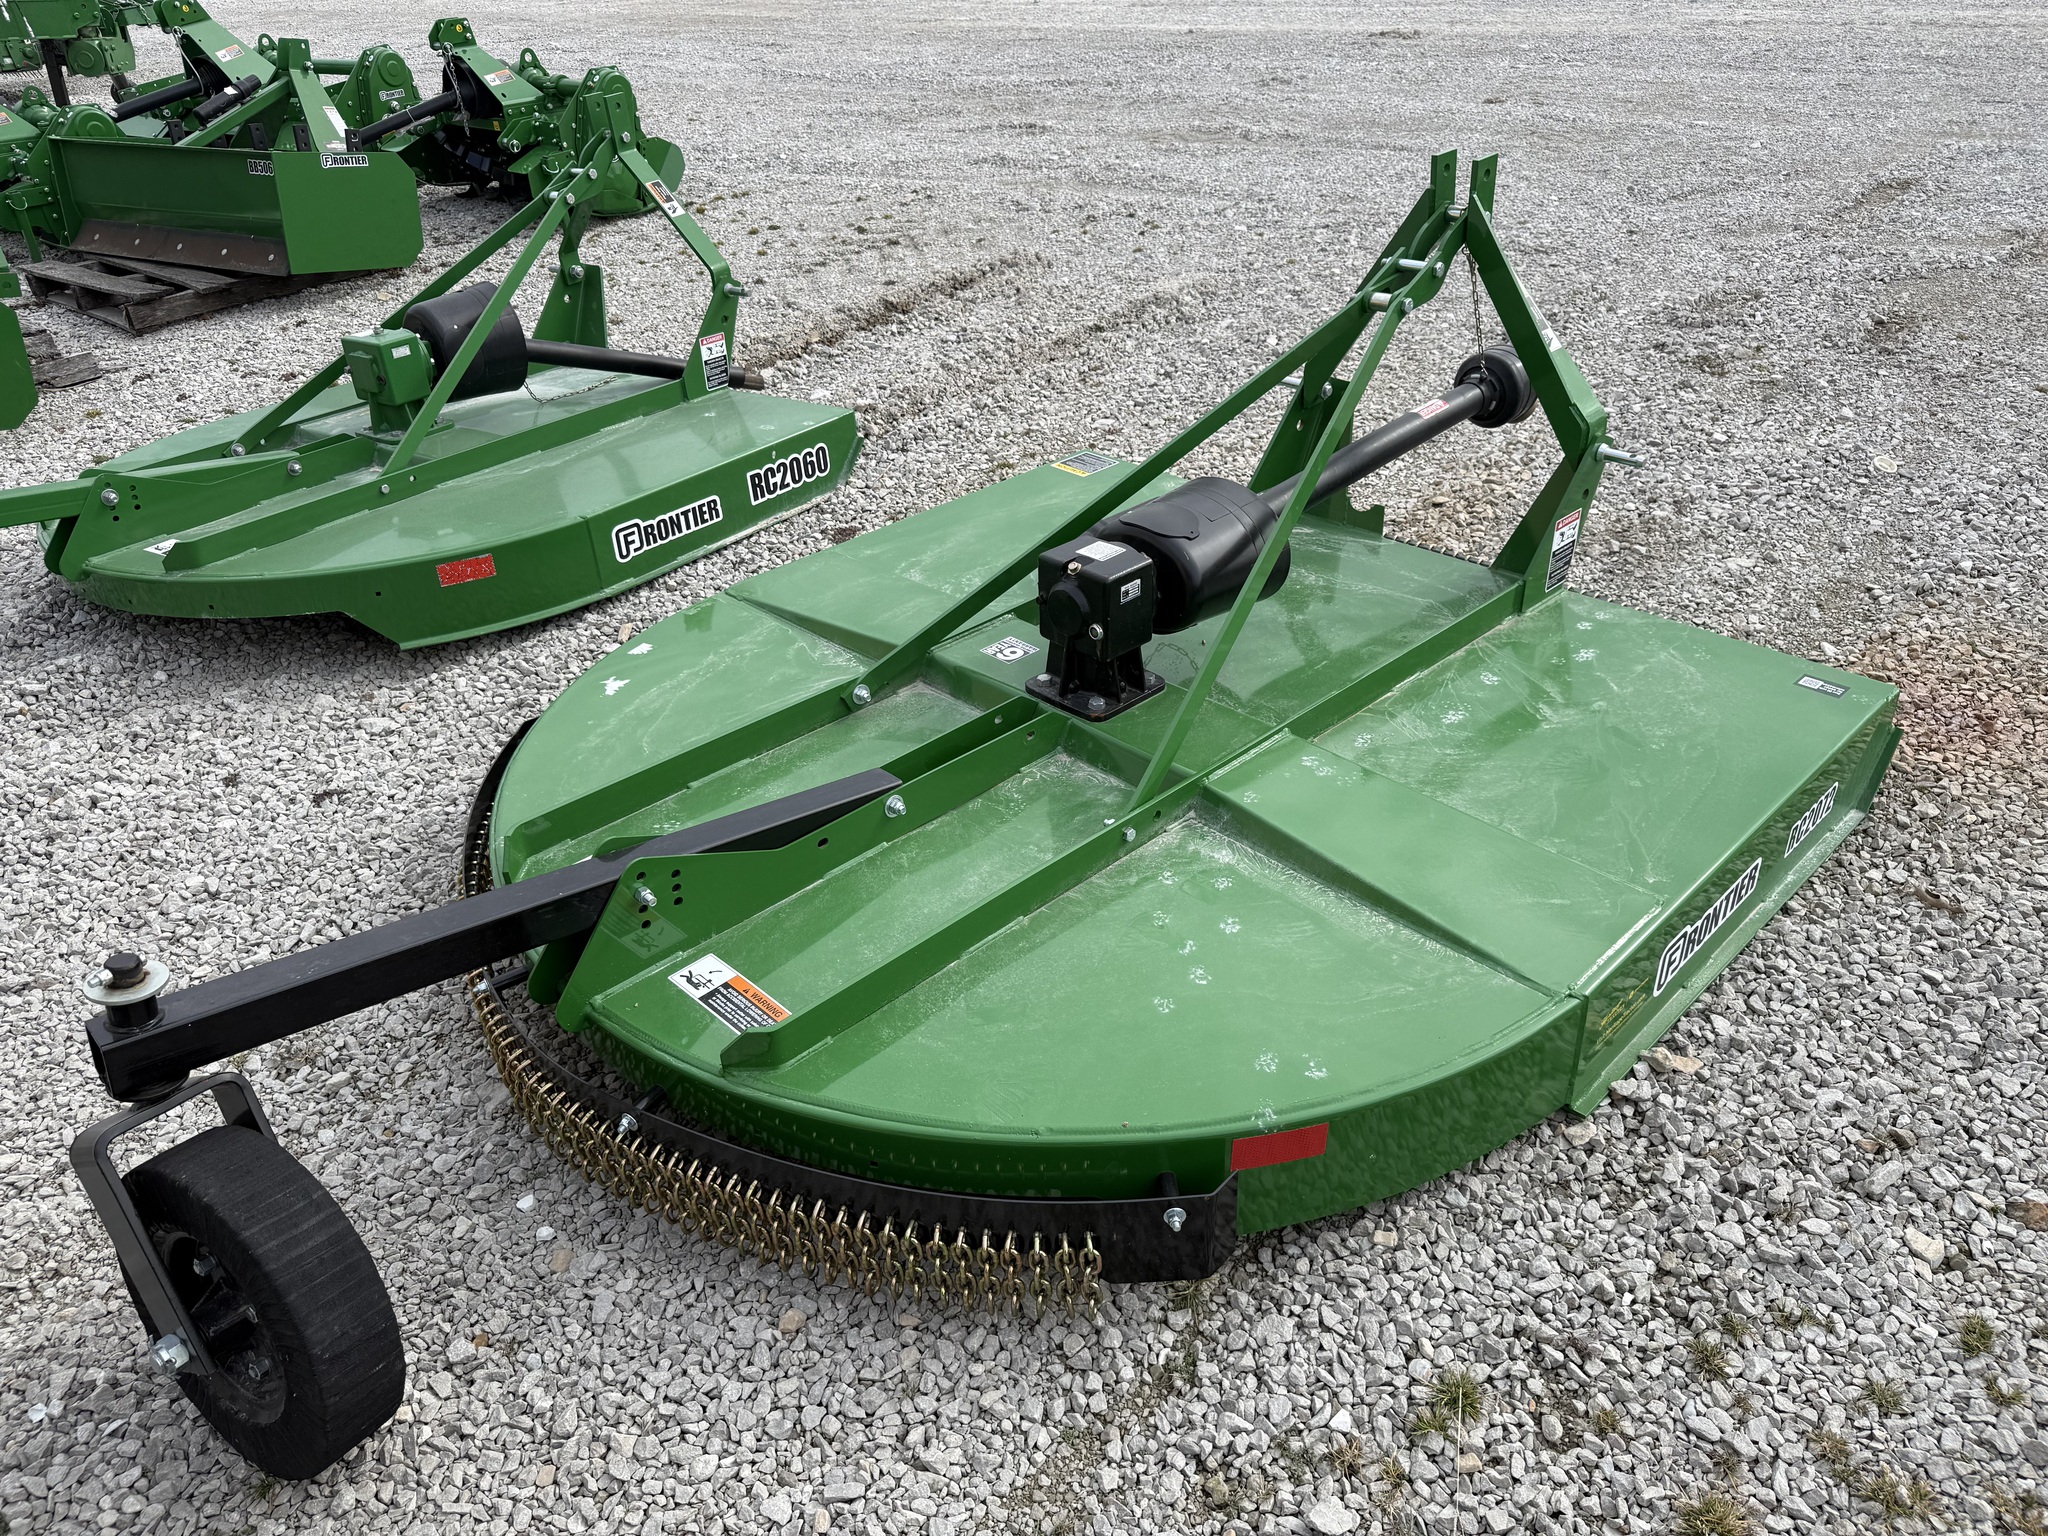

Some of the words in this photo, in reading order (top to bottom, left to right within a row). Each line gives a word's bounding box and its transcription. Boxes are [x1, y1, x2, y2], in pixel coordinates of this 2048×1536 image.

[248, 160, 274, 175] BB506
[321, 154, 368, 167] FRONTIER
[749, 445, 830, 502] RC2060
[614, 498, 721, 560] FRONTIER
[1787, 785, 1837, 855] RC2072
[1655, 863, 1759, 992] FRONTIER
[750, 991, 783, 1018] WARNING
